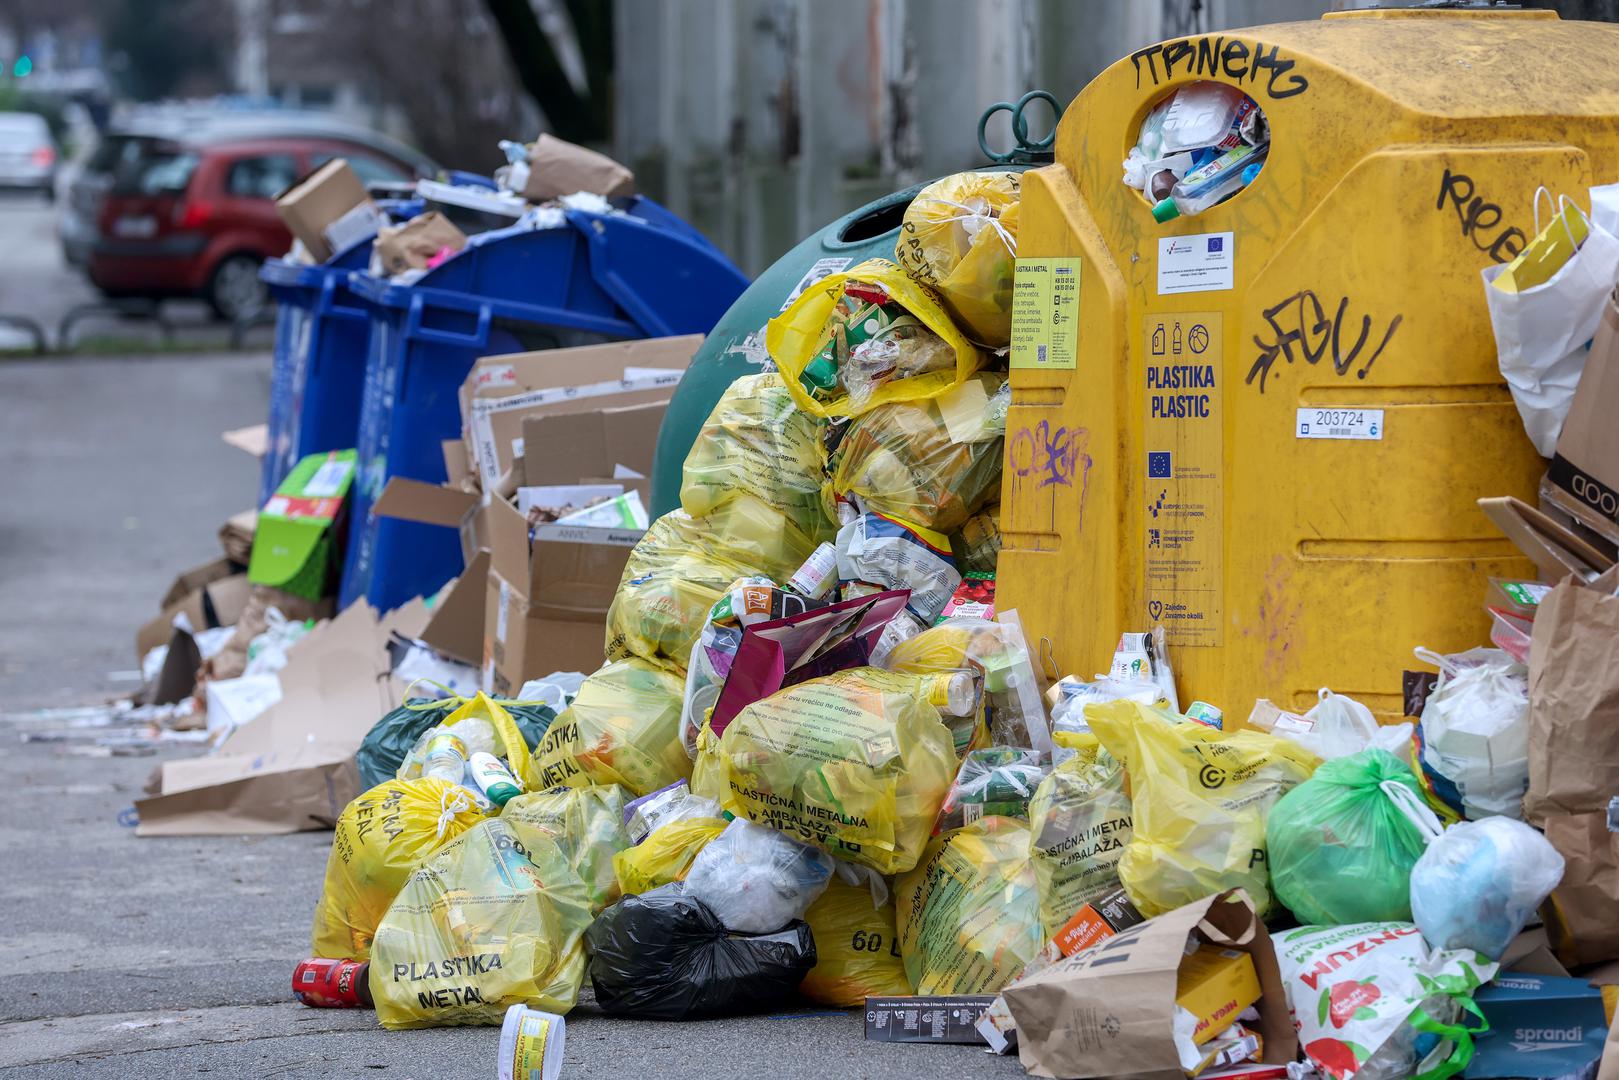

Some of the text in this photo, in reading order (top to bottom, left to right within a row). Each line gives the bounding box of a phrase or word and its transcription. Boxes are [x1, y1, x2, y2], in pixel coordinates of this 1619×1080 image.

[1016, 265, 1031, 273] LASTIKA
[1148, 366, 1215, 389] PLASTIKA
[1152, 394, 1210, 418] PLASTIC
[1316, 411, 1364, 426] 203724
[1165, 603, 1187, 611] Zajedno
[802, 697, 825, 707] vrećicu
[835, 706, 863, 718] odlagati:
[730, 780, 797, 810] PLASTIČNA
[806, 805, 869, 828] METALNA
[1082, 862, 1111, 877] potrebno
[852, 930, 902, 958] 60 L
[1075, 920, 1103, 951] MARGHERITA
[393, 953, 503, 982] PLASTIKA
[1211, 999, 1239, 1022] MEGA
[1515, 1026, 1582, 1042] sprandi
